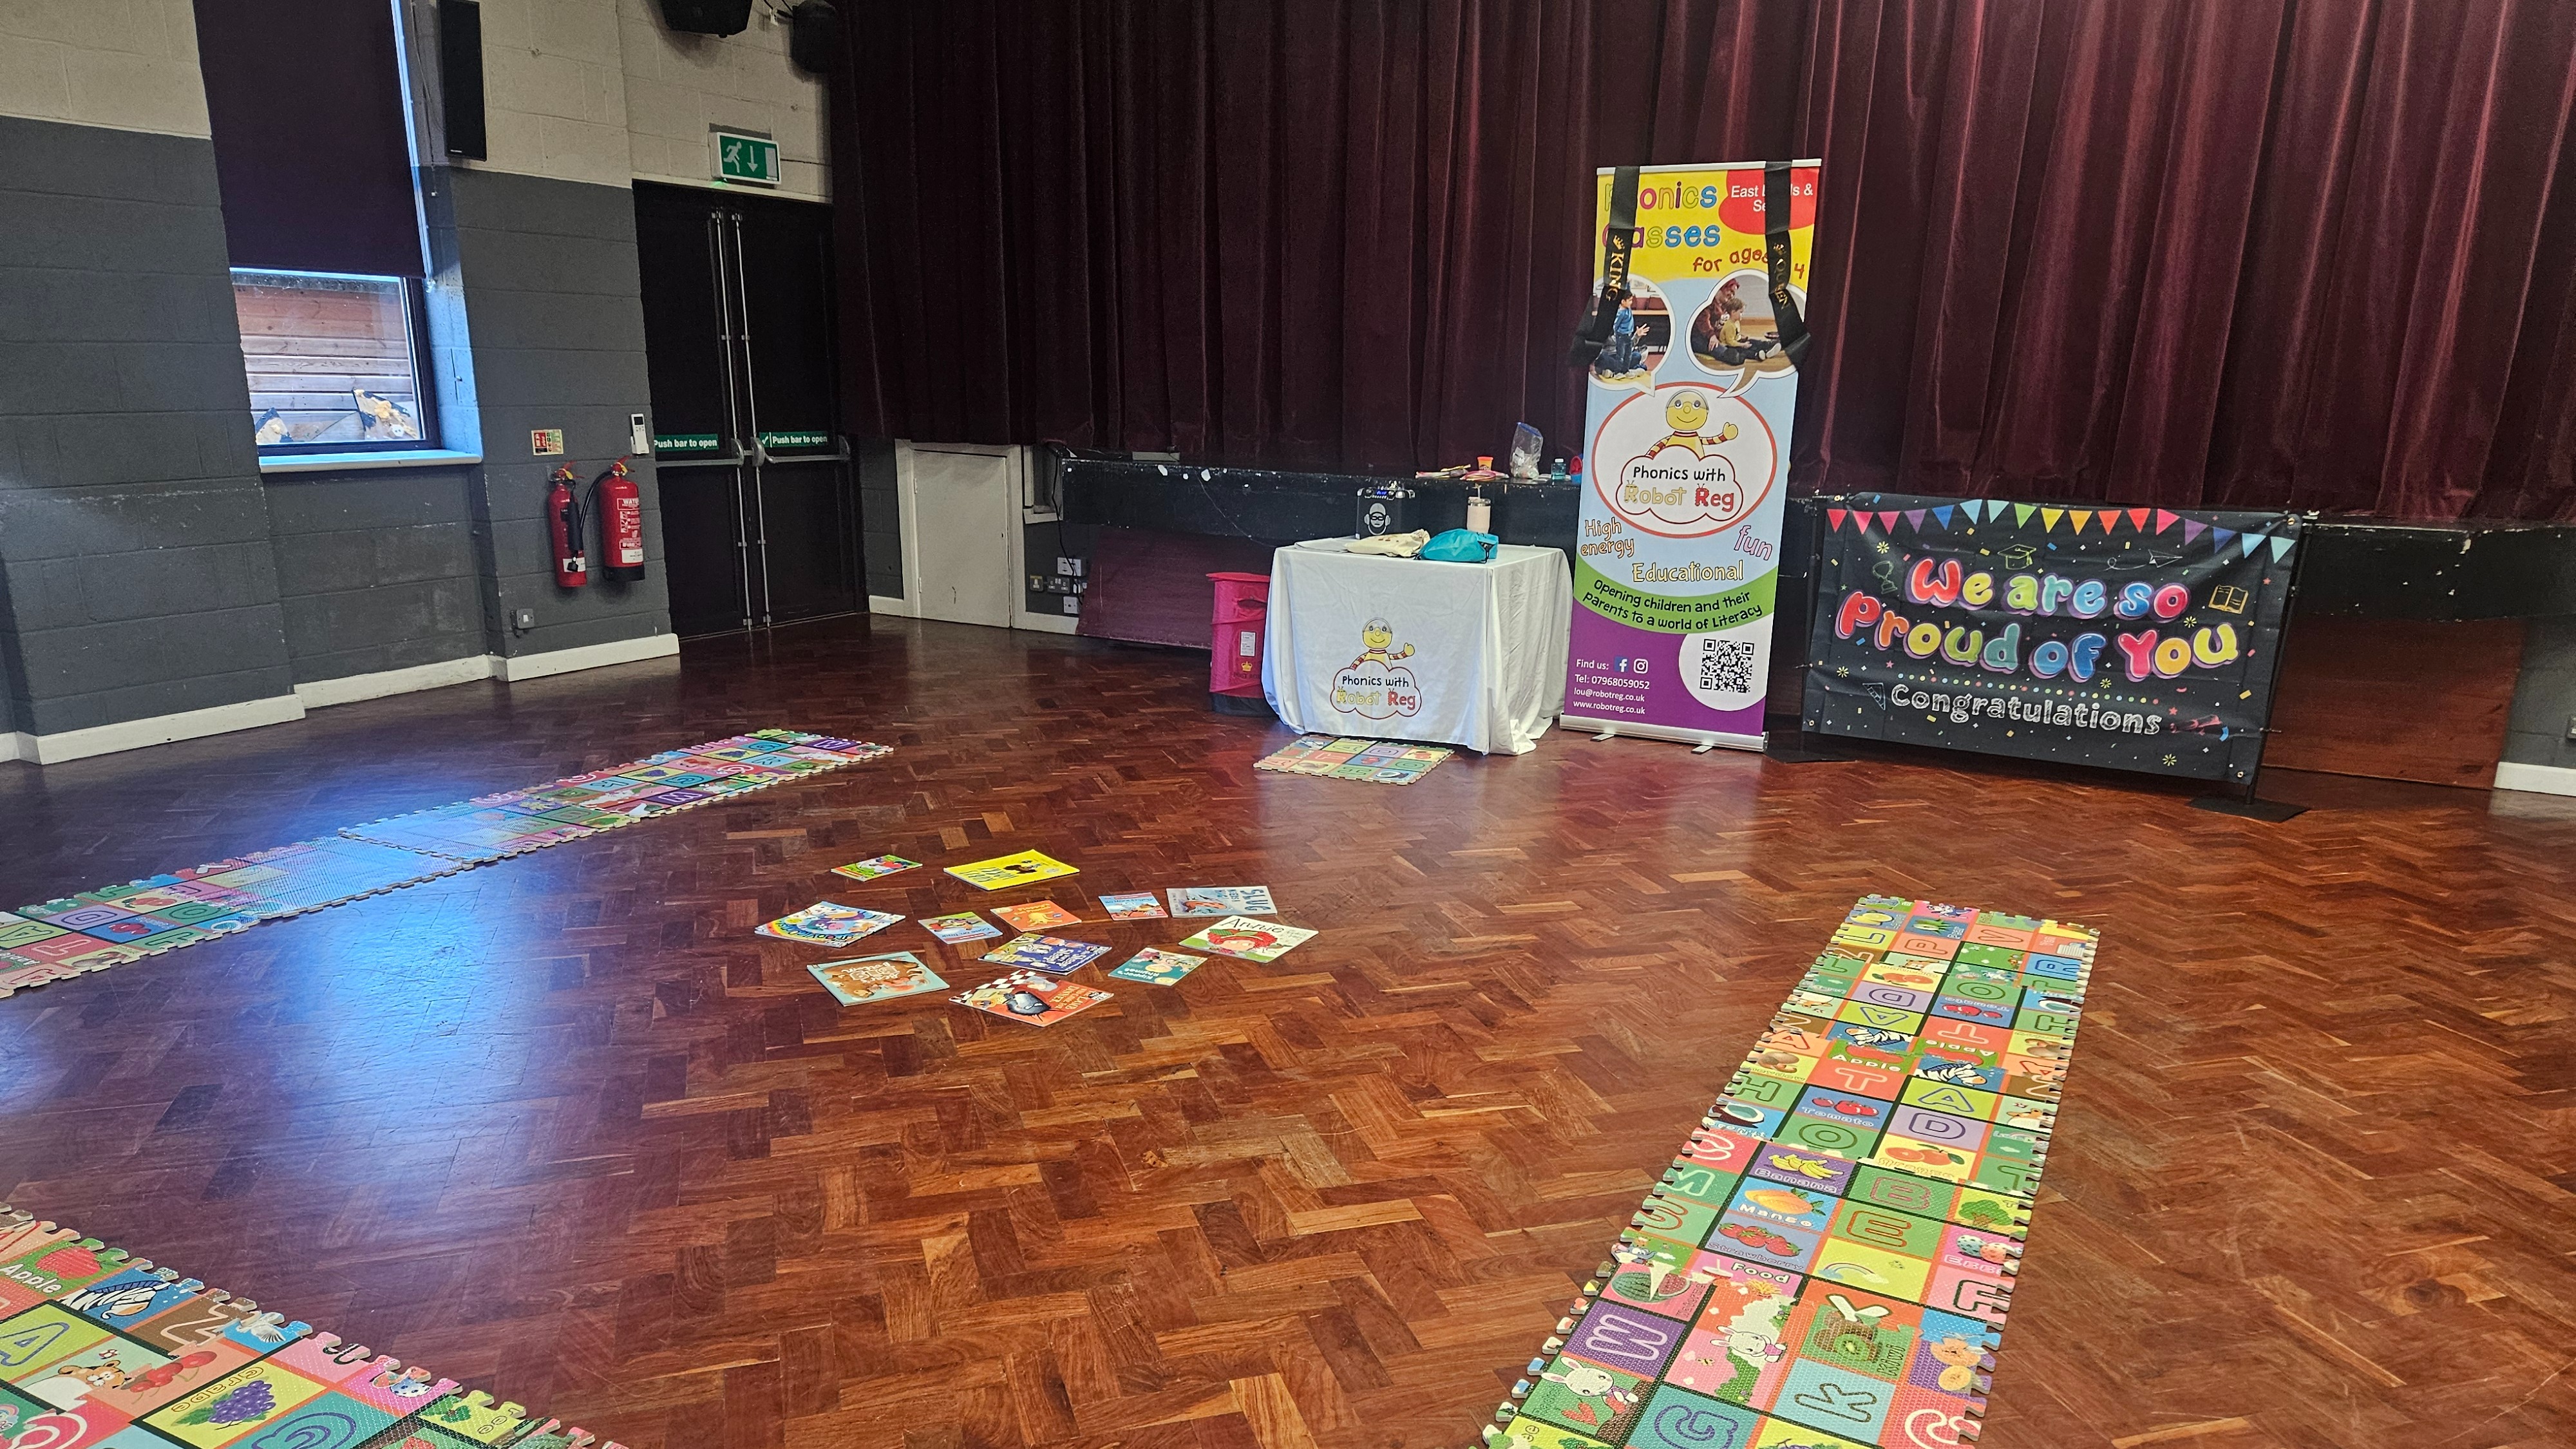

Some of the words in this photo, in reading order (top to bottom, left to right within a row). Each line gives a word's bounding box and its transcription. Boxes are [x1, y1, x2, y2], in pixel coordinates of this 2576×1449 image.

[1605, 181, 1717, 211] onics
[1731, 185, 1758, 198] East
[1804, 183, 1814, 196] &
[1602, 223, 1720, 248] asses
[1605, 252, 1625, 301] KING
[1692, 257, 1722, 272] for
[1794, 263, 1804, 279] 4
[654, 440, 672, 448] Push
[676, 439, 687, 448] bar
[689, 439, 697, 448] to
[699, 440, 717, 448] open
[773, 436, 790, 444] Push
[790, 435, 802, 444] bar
[811, 436, 828, 444] open
[1633, 466, 1689, 481] Phonics
[1694, 468, 1726, 482] with
[1624, 480, 1687, 506] Robot
[1694, 483, 1734, 512] Reg
[1584, 516, 1622, 542] High
[1580, 537, 1634, 559] energy
[1734, 525, 1773, 561] fun
[1632, 560, 1745, 583] Educational
[1593, 579, 1642, 608] Opening
[1643, 598, 1692, 612] children
[1694, 600, 1720, 612] and
[1722, 591, 1751, 609] their
[1904, 557, 1995, 611] We
[2001, 572, 2107, 619] are
[2114, 580, 2192, 623] so
[1583, 591, 1629, 619] parents
[1632, 611, 1643, 623] to
[1647, 616, 1654, 626] a
[1658, 618, 1692, 630] world
[1695, 618, 1709, 629] of
[1712, 604, 1763, 628] Literacy
[1576, 659, 1595, 668] Find
[1342, 675, 1382, 686] Phonics
[1385, 677, 1409, 687] with
[1575, 674, 1590, 683] Tel:
[1591, 676, 1650, 690] 07968059052
[1336, 687, 1381, 706] Robot
[1387, 688, 1416, 710] Reg
[1573, 687, 1645, 702] lou@robotreg.co.uk
[1573, 701, 1645, 715] www.robotreg.co.uk
[1891, 683, 2163, 735] Congratulations
[1239, 888, 1271, 911] SLUG
[1220, 916, 1285, 933] Annie
[1905, 938, 1948, 954] P
[1868, 988, 1917, 1007] D
[1956, 982, 2005, 999] O
[1860, 1006, 1909, 1026] A
[1937, 1023, 1989, 1045] T
[1924, 1039, 1996, 1057] Apple
[1832, 1054, 1902, 1072] Apple
[1835, 1067, 1888, 1092] T
[1918, 1088, 1975, 1113] A
[1801, 1106, 1874, 1127] Tomato
[1908, 1113, 1966, 1139] D
[1799, 1123, 1858, 1150] O
[1755, 1168, 1837, 1193] Banana
[1870, 1176, 1931, 1210] B
[1739, 1203, 1813, 1227] Mango
[1846, 1210, 1912, 1247] E
[1707, 1241, 1804, 1271] Strawberry
[0, 1264, 62, 1293] Apple
[1731, 1260, 1790, 1285] Food
